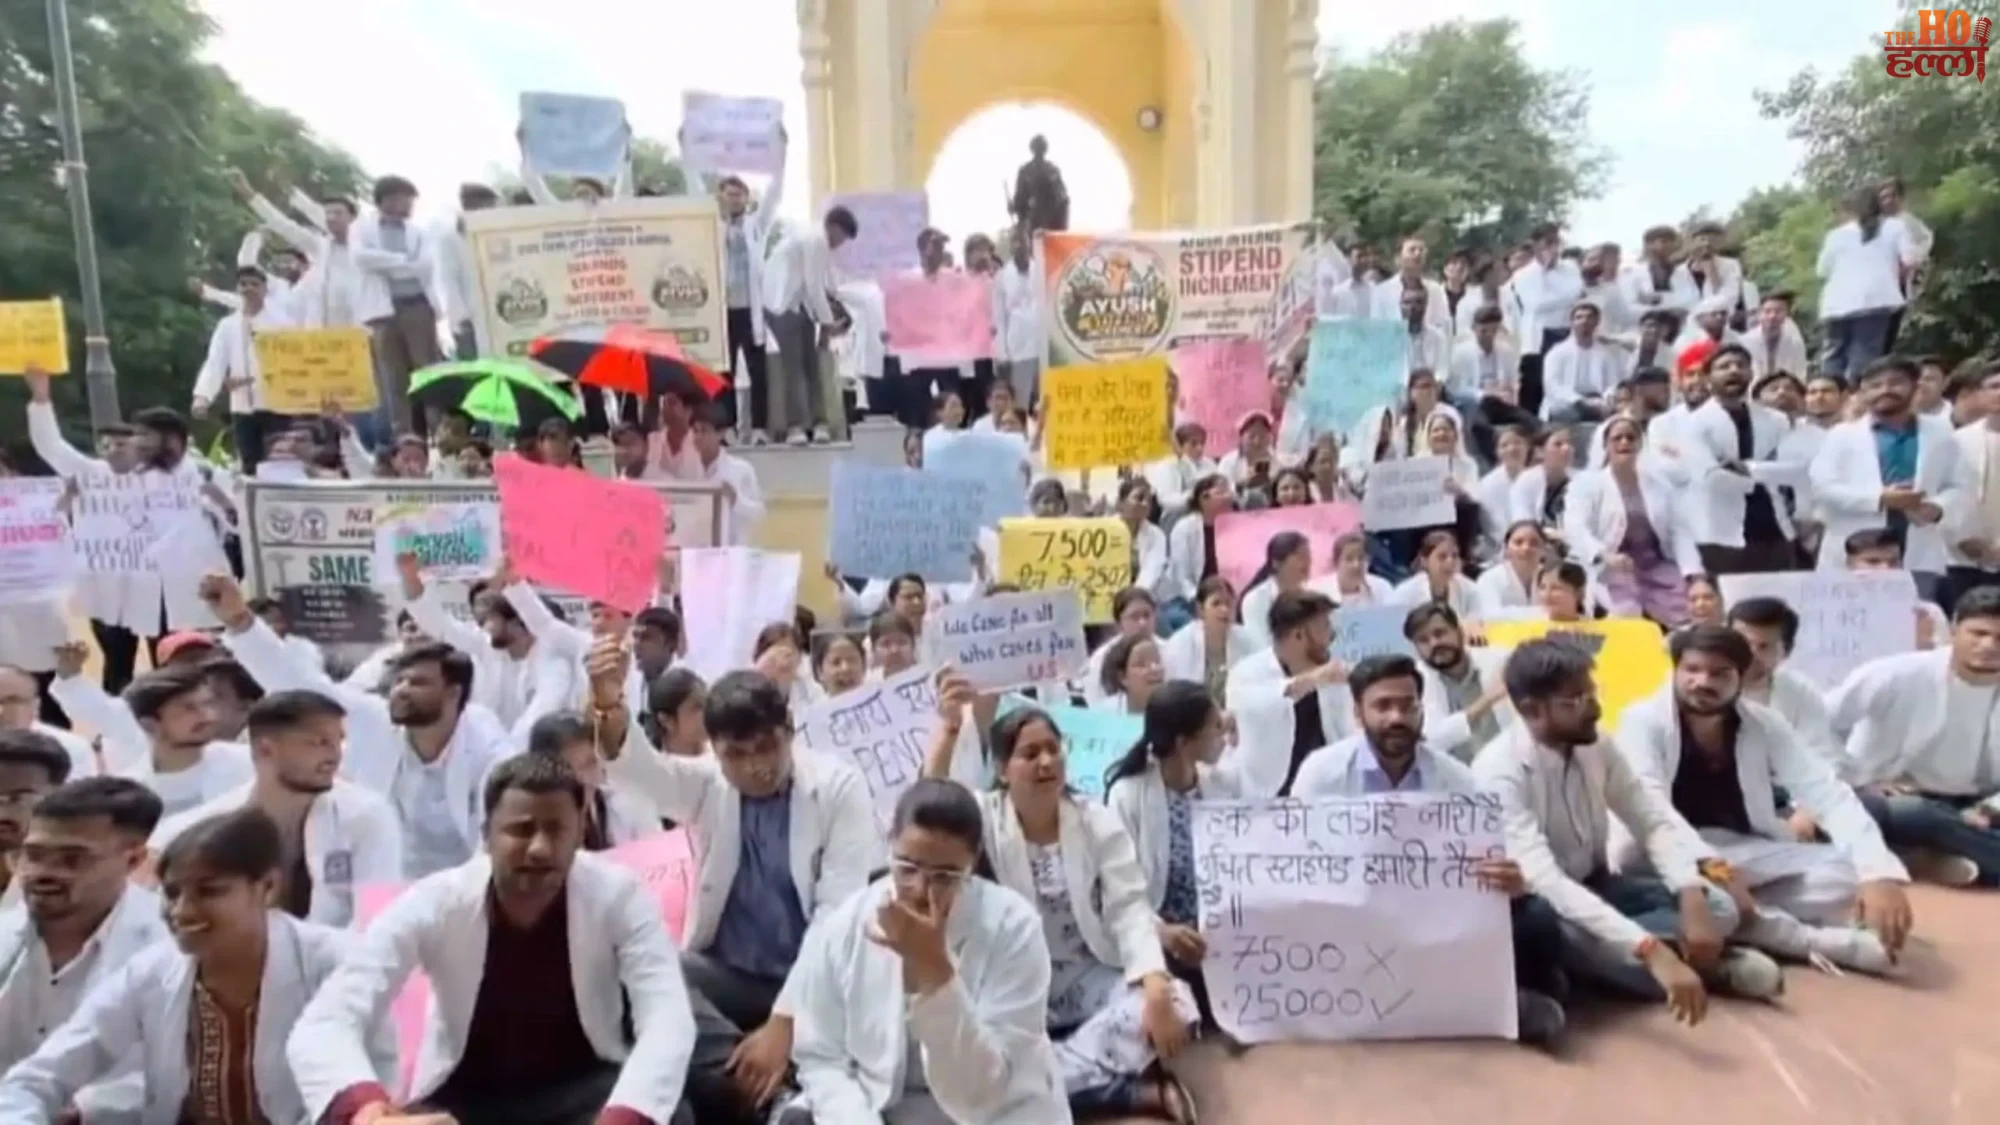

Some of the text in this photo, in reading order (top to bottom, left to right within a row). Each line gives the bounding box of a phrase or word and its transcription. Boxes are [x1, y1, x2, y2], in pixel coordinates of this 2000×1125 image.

[1179, 246, 1282, 275] STIPEND
[1179, 272, 1282, 298] INCREMENT
[308, 555, 371, 583] SAME
[1264, 797, 1313, 838] की
[1231, 935, 1346, 976] 7500
[1233, 982, 1364, 1027] 25000
